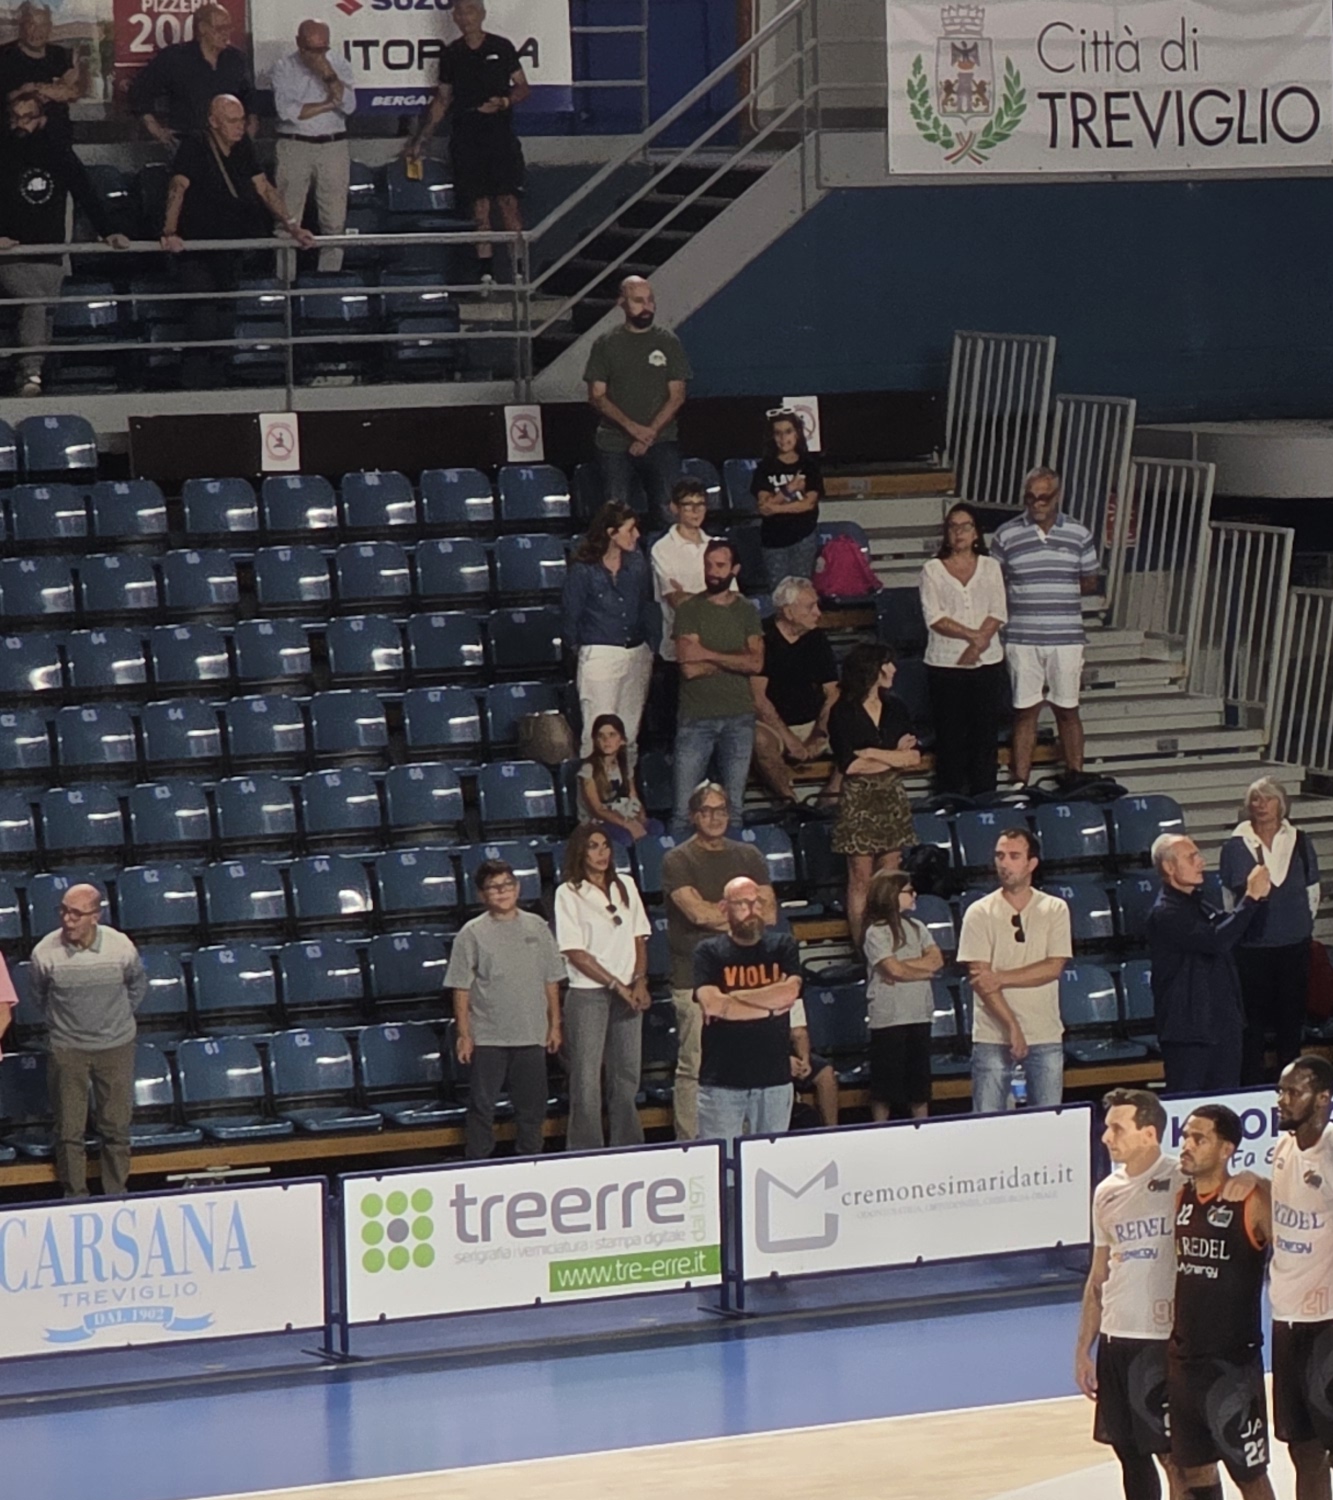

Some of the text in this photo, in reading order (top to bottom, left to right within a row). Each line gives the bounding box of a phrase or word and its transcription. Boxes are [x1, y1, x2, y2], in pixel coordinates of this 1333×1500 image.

[1037, 16, 1199, 73] Città di
[1036, 85, 1321, 149] TREVIGLIO
[840, 1163, 1075, 1207] cremonesimaridati.it
[449, 1177, 687, 1244] treerre
[1114, 1217, 1173, 1245] REDEL
[0, 1199, 257, 1294] CARSANA
[596, 1234, 642, 1251] stampa
[644, 1229, 686, 1246] digitale
[557, 1250, 707, 1288] www.tre-erre.it
[58, 1281, 199, 1308] TREVIGLIO
